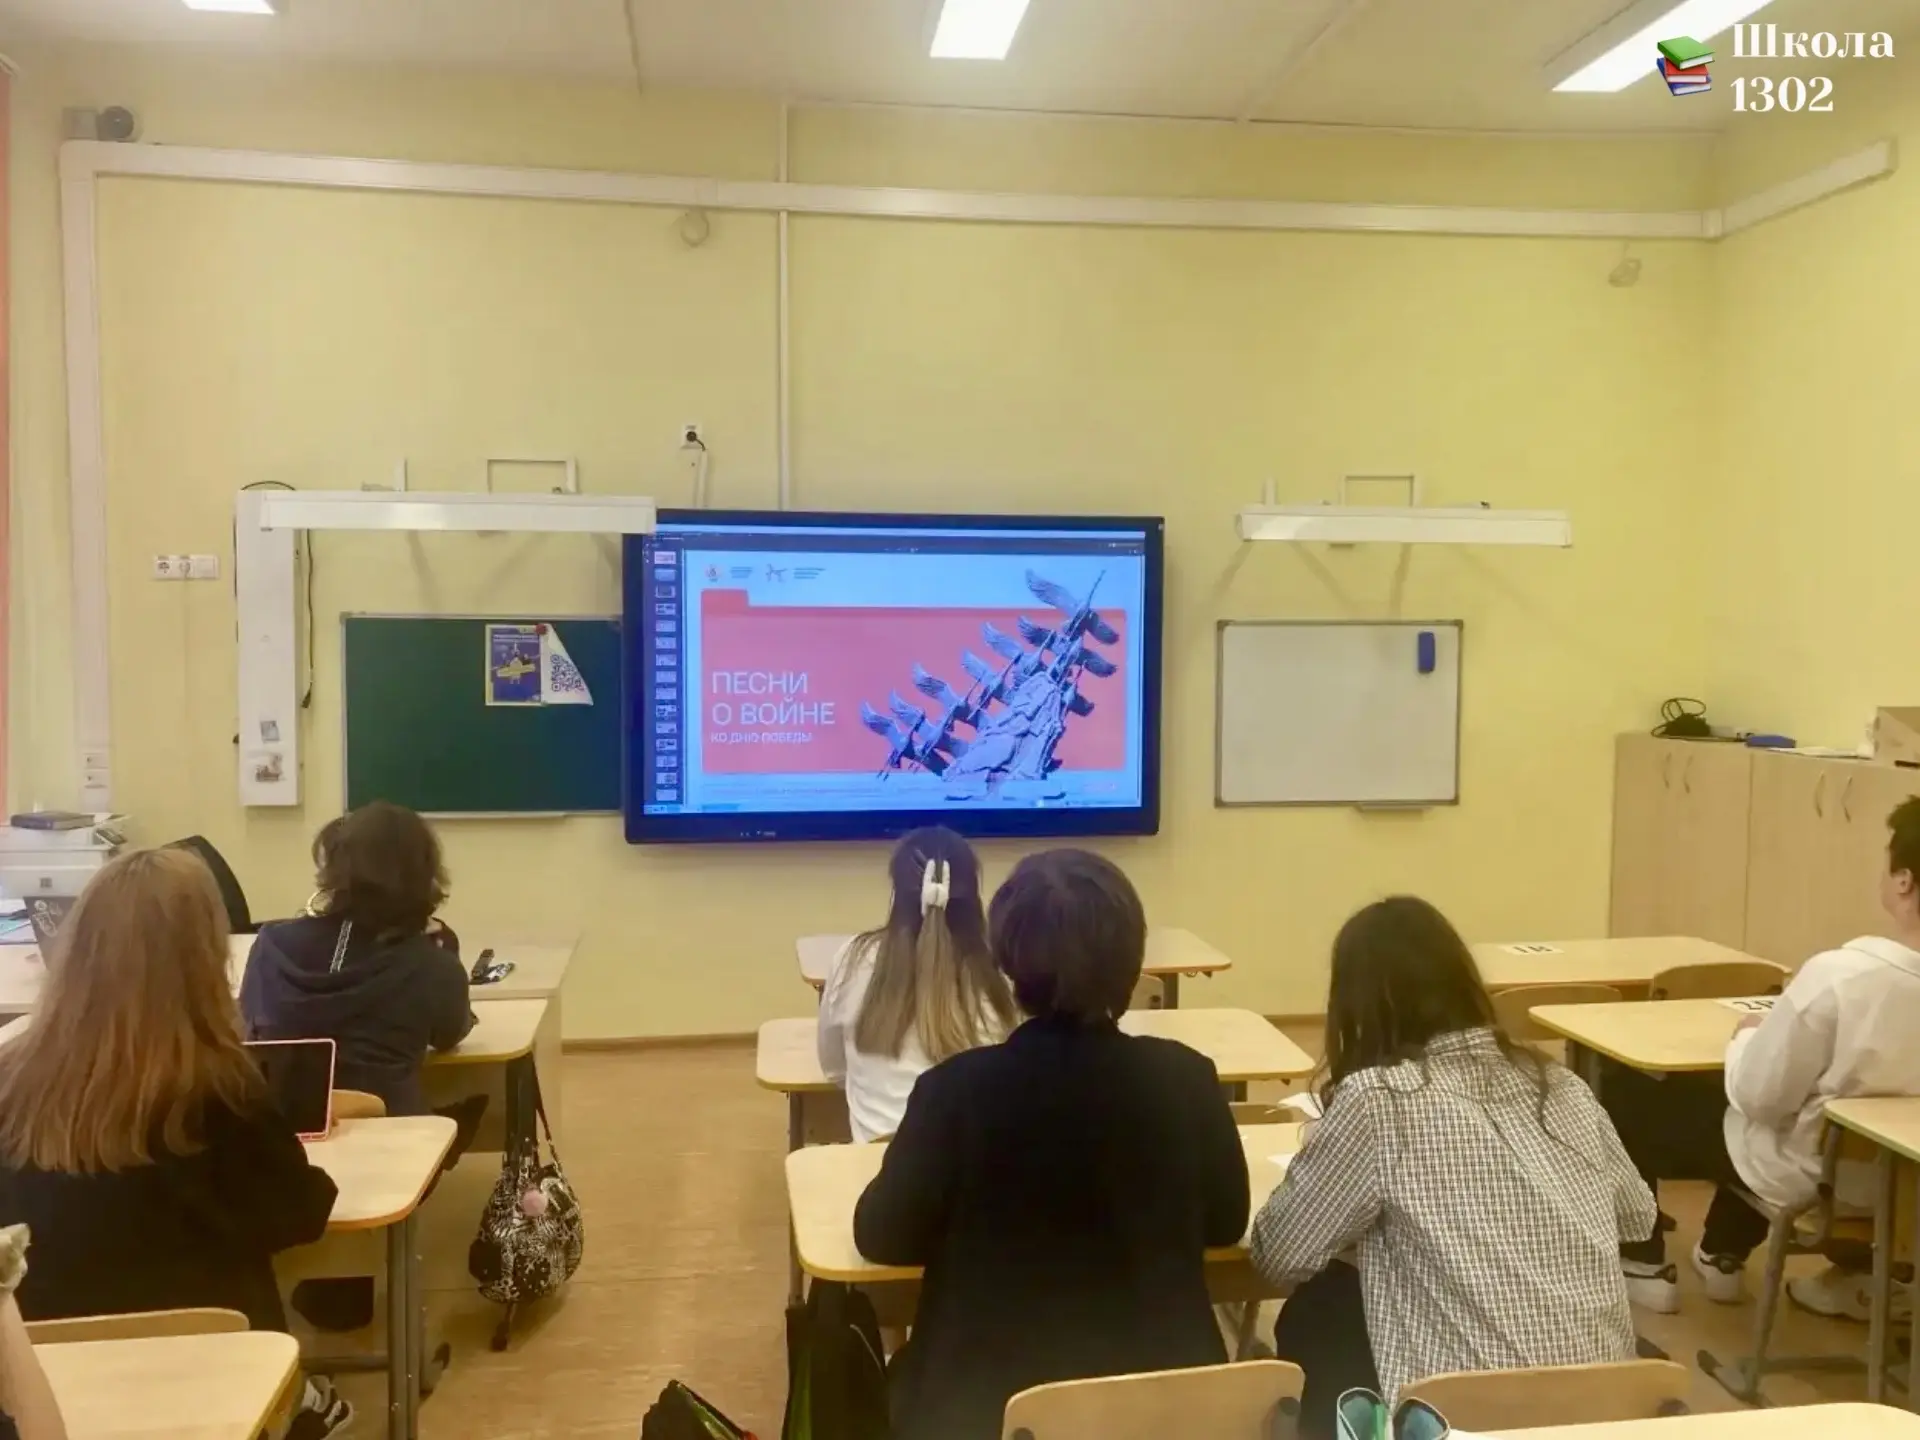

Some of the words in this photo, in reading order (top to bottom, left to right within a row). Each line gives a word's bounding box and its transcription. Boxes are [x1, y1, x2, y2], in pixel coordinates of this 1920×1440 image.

[712, 671, 808, 694] ПЕСНИ
[712, 702, 732, 725] О
[741, 695, 836, 725] ВОЙНЕ
[710, 732, 728, 743] КО
